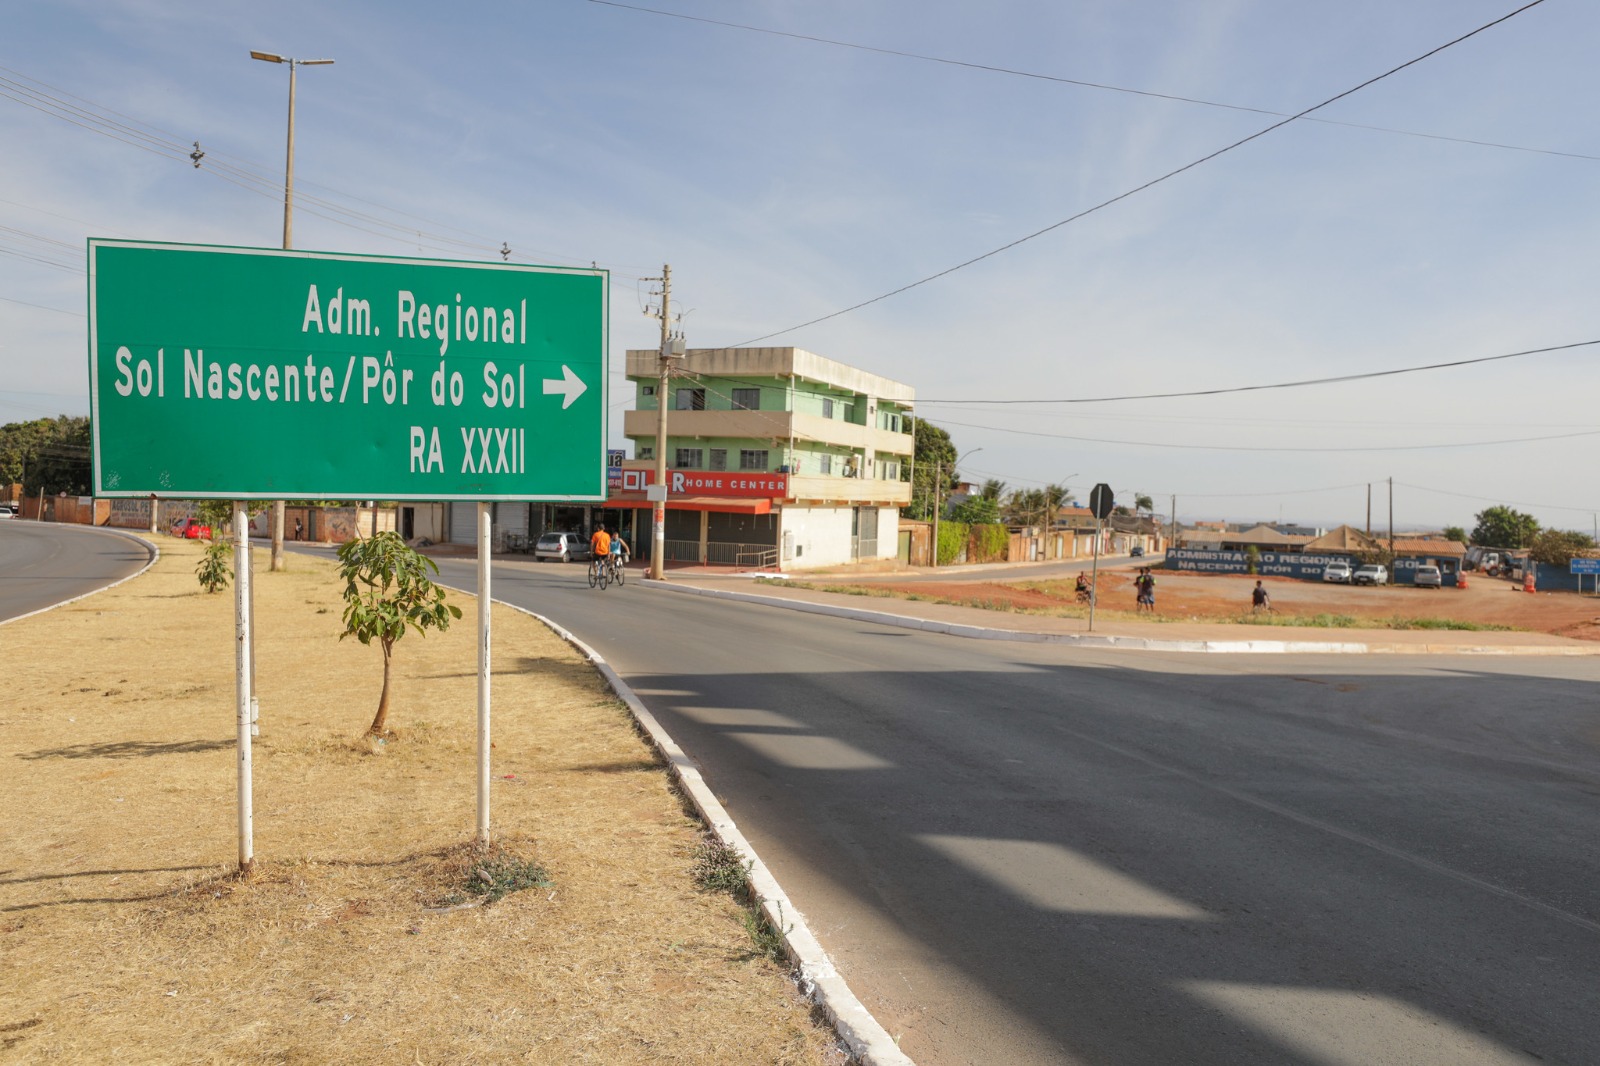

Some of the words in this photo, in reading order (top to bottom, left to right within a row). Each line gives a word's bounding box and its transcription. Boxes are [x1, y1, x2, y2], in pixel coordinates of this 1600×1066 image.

[302, 285, 380, 336] Adm.
[398, 290, 527, 356] Regional
[114, 346, 165, 397] Sol
[184, 349, 414, 405] Nascente/Pôr
[431, 361, 464, 406] do
[482, 362, 526, 408] Sol
[409, 426, 444, 474] RA
[461, 427, 526, 474] XXXII
[623, 470, 685, 493] OLR
[686, 479, 722, 488] HOME
[730, 480, 785, 490] CENTER
